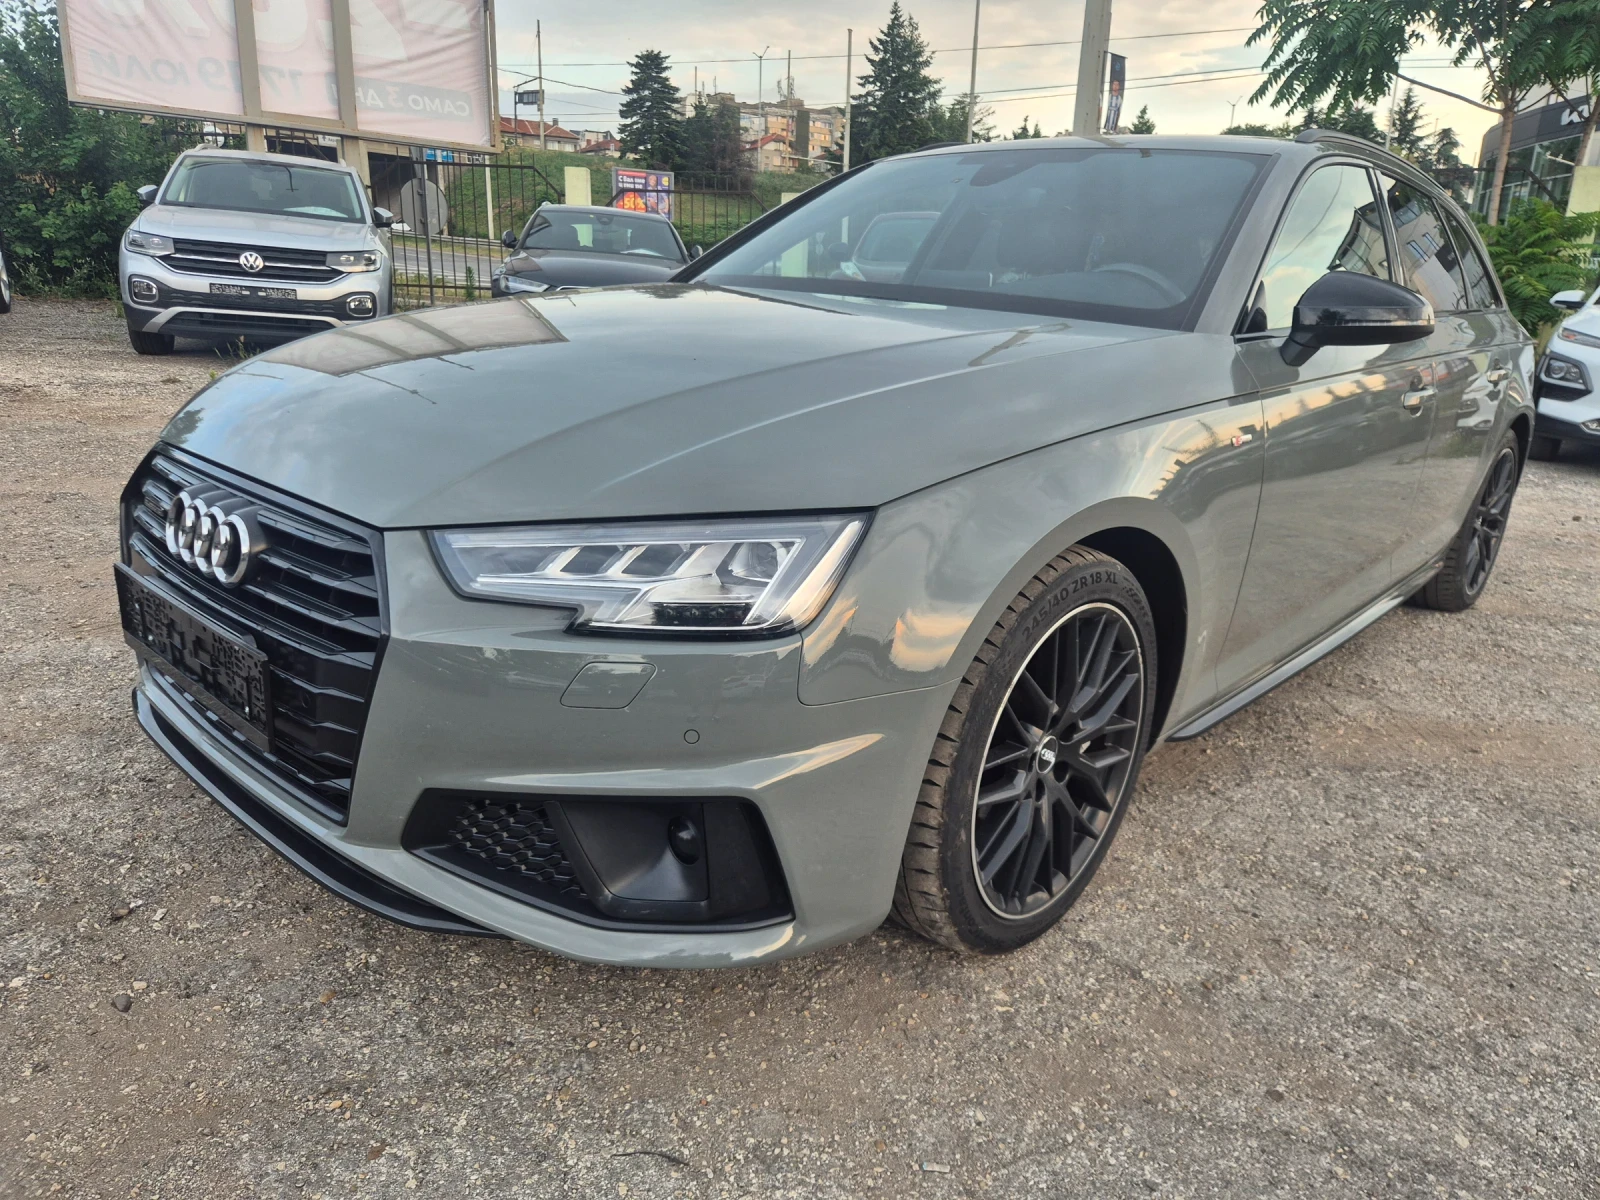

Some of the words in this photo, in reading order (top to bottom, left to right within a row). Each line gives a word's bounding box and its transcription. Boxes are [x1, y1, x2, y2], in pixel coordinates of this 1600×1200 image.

[1021, 587, 1070, 641] 245/40
[1072, 576, 1088, 593] ZR
[1090, 571, 1103, 585] 18
[1104, 570, 1118, 585] XL
